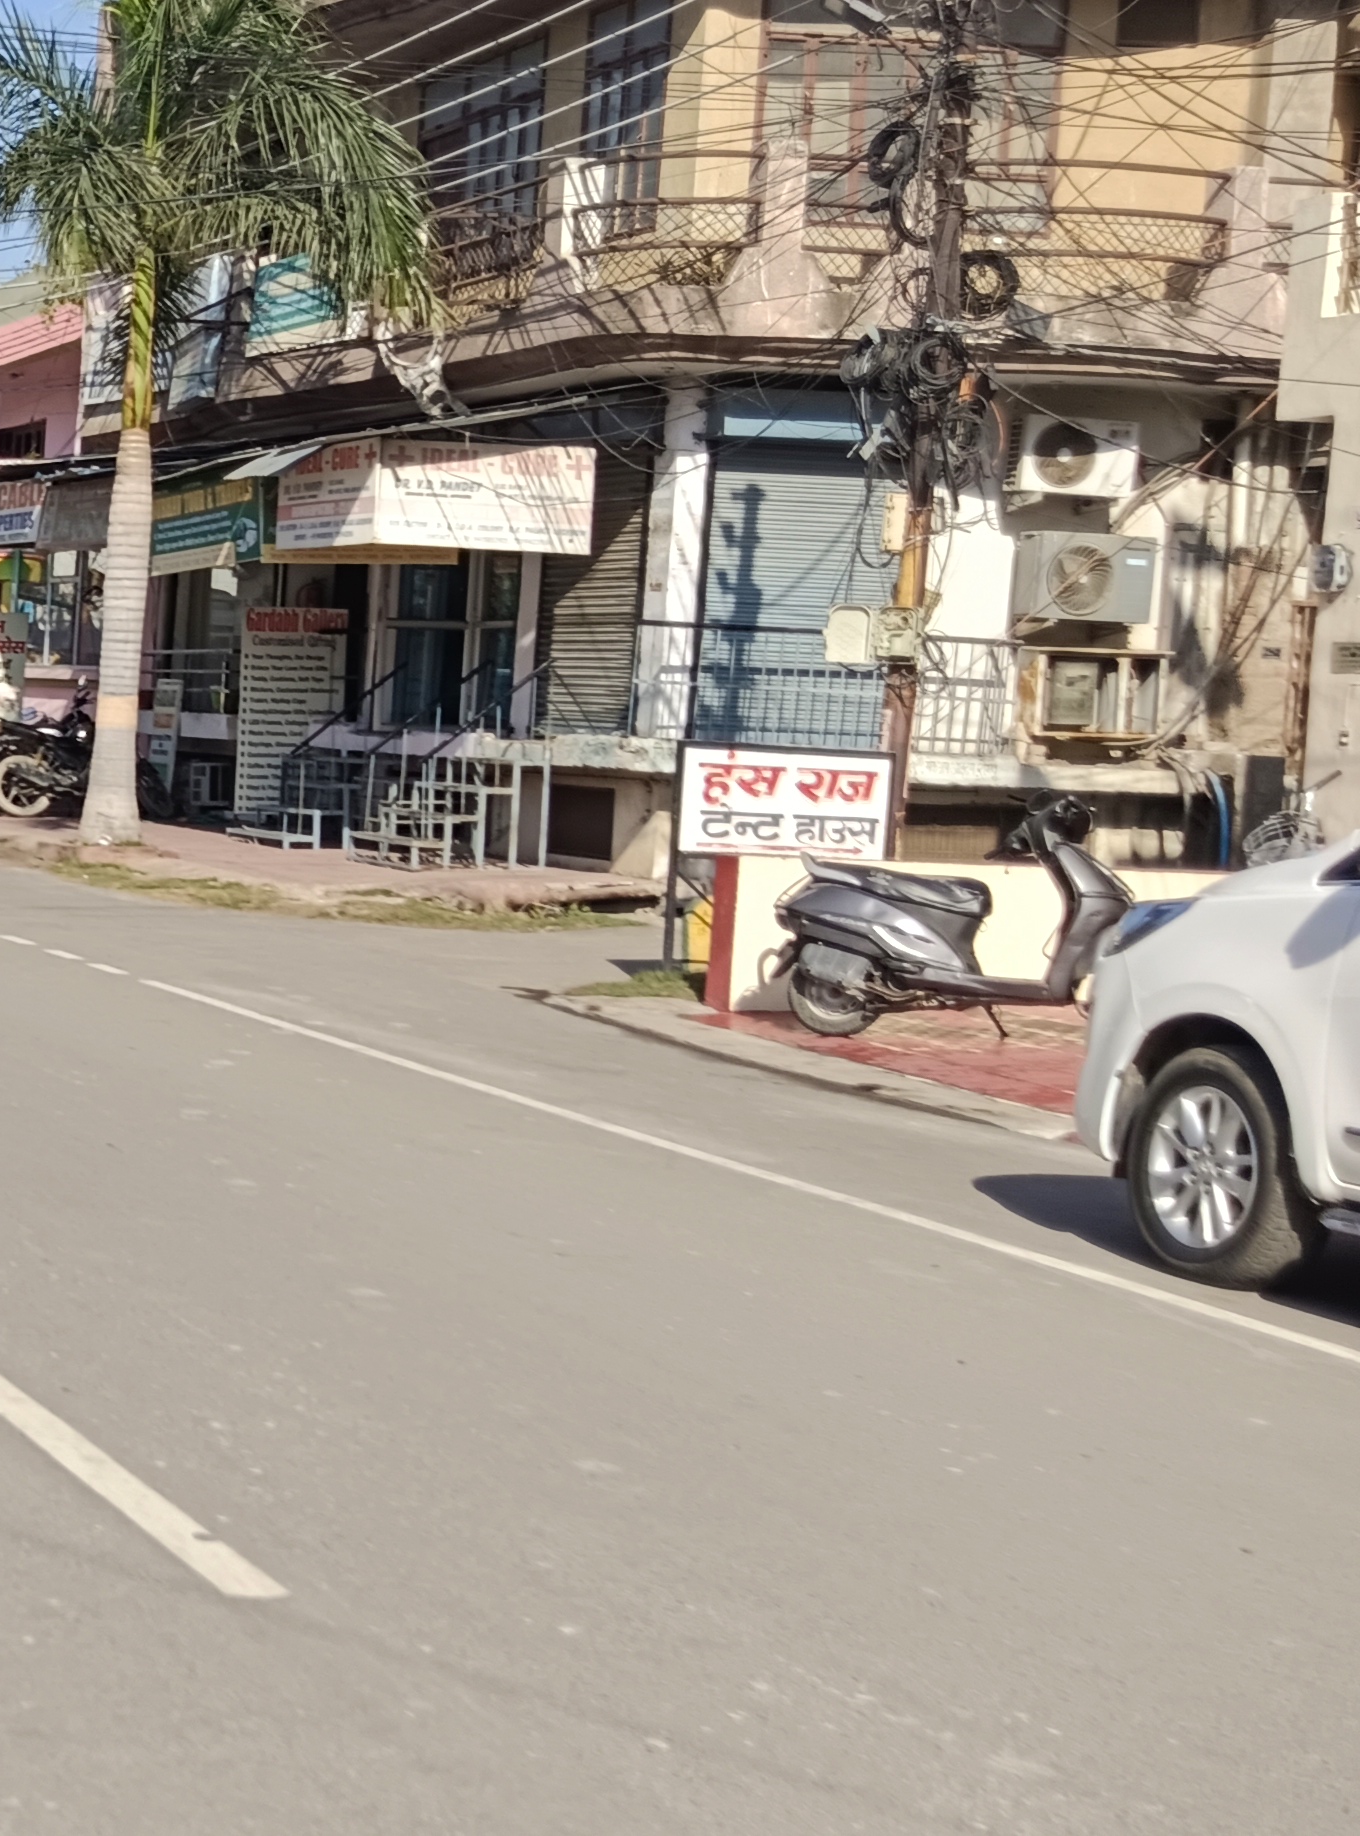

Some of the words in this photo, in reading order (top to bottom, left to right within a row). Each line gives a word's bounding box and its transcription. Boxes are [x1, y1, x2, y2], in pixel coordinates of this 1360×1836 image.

[332, 446, 360, 471] CURE
[421, 447, 480, 474] IDEAL
[501, 453, 559, 478] CURE
[246, 607, 299, 632] Gardabh
[303, 608, 349, 633] Gallery
[698, 749, 787, 805] हंस
[794, 767, 879, 804] राज
[700, 802, 785, 841] टेन्ट
[792, 814, 880, 847] हाउस
